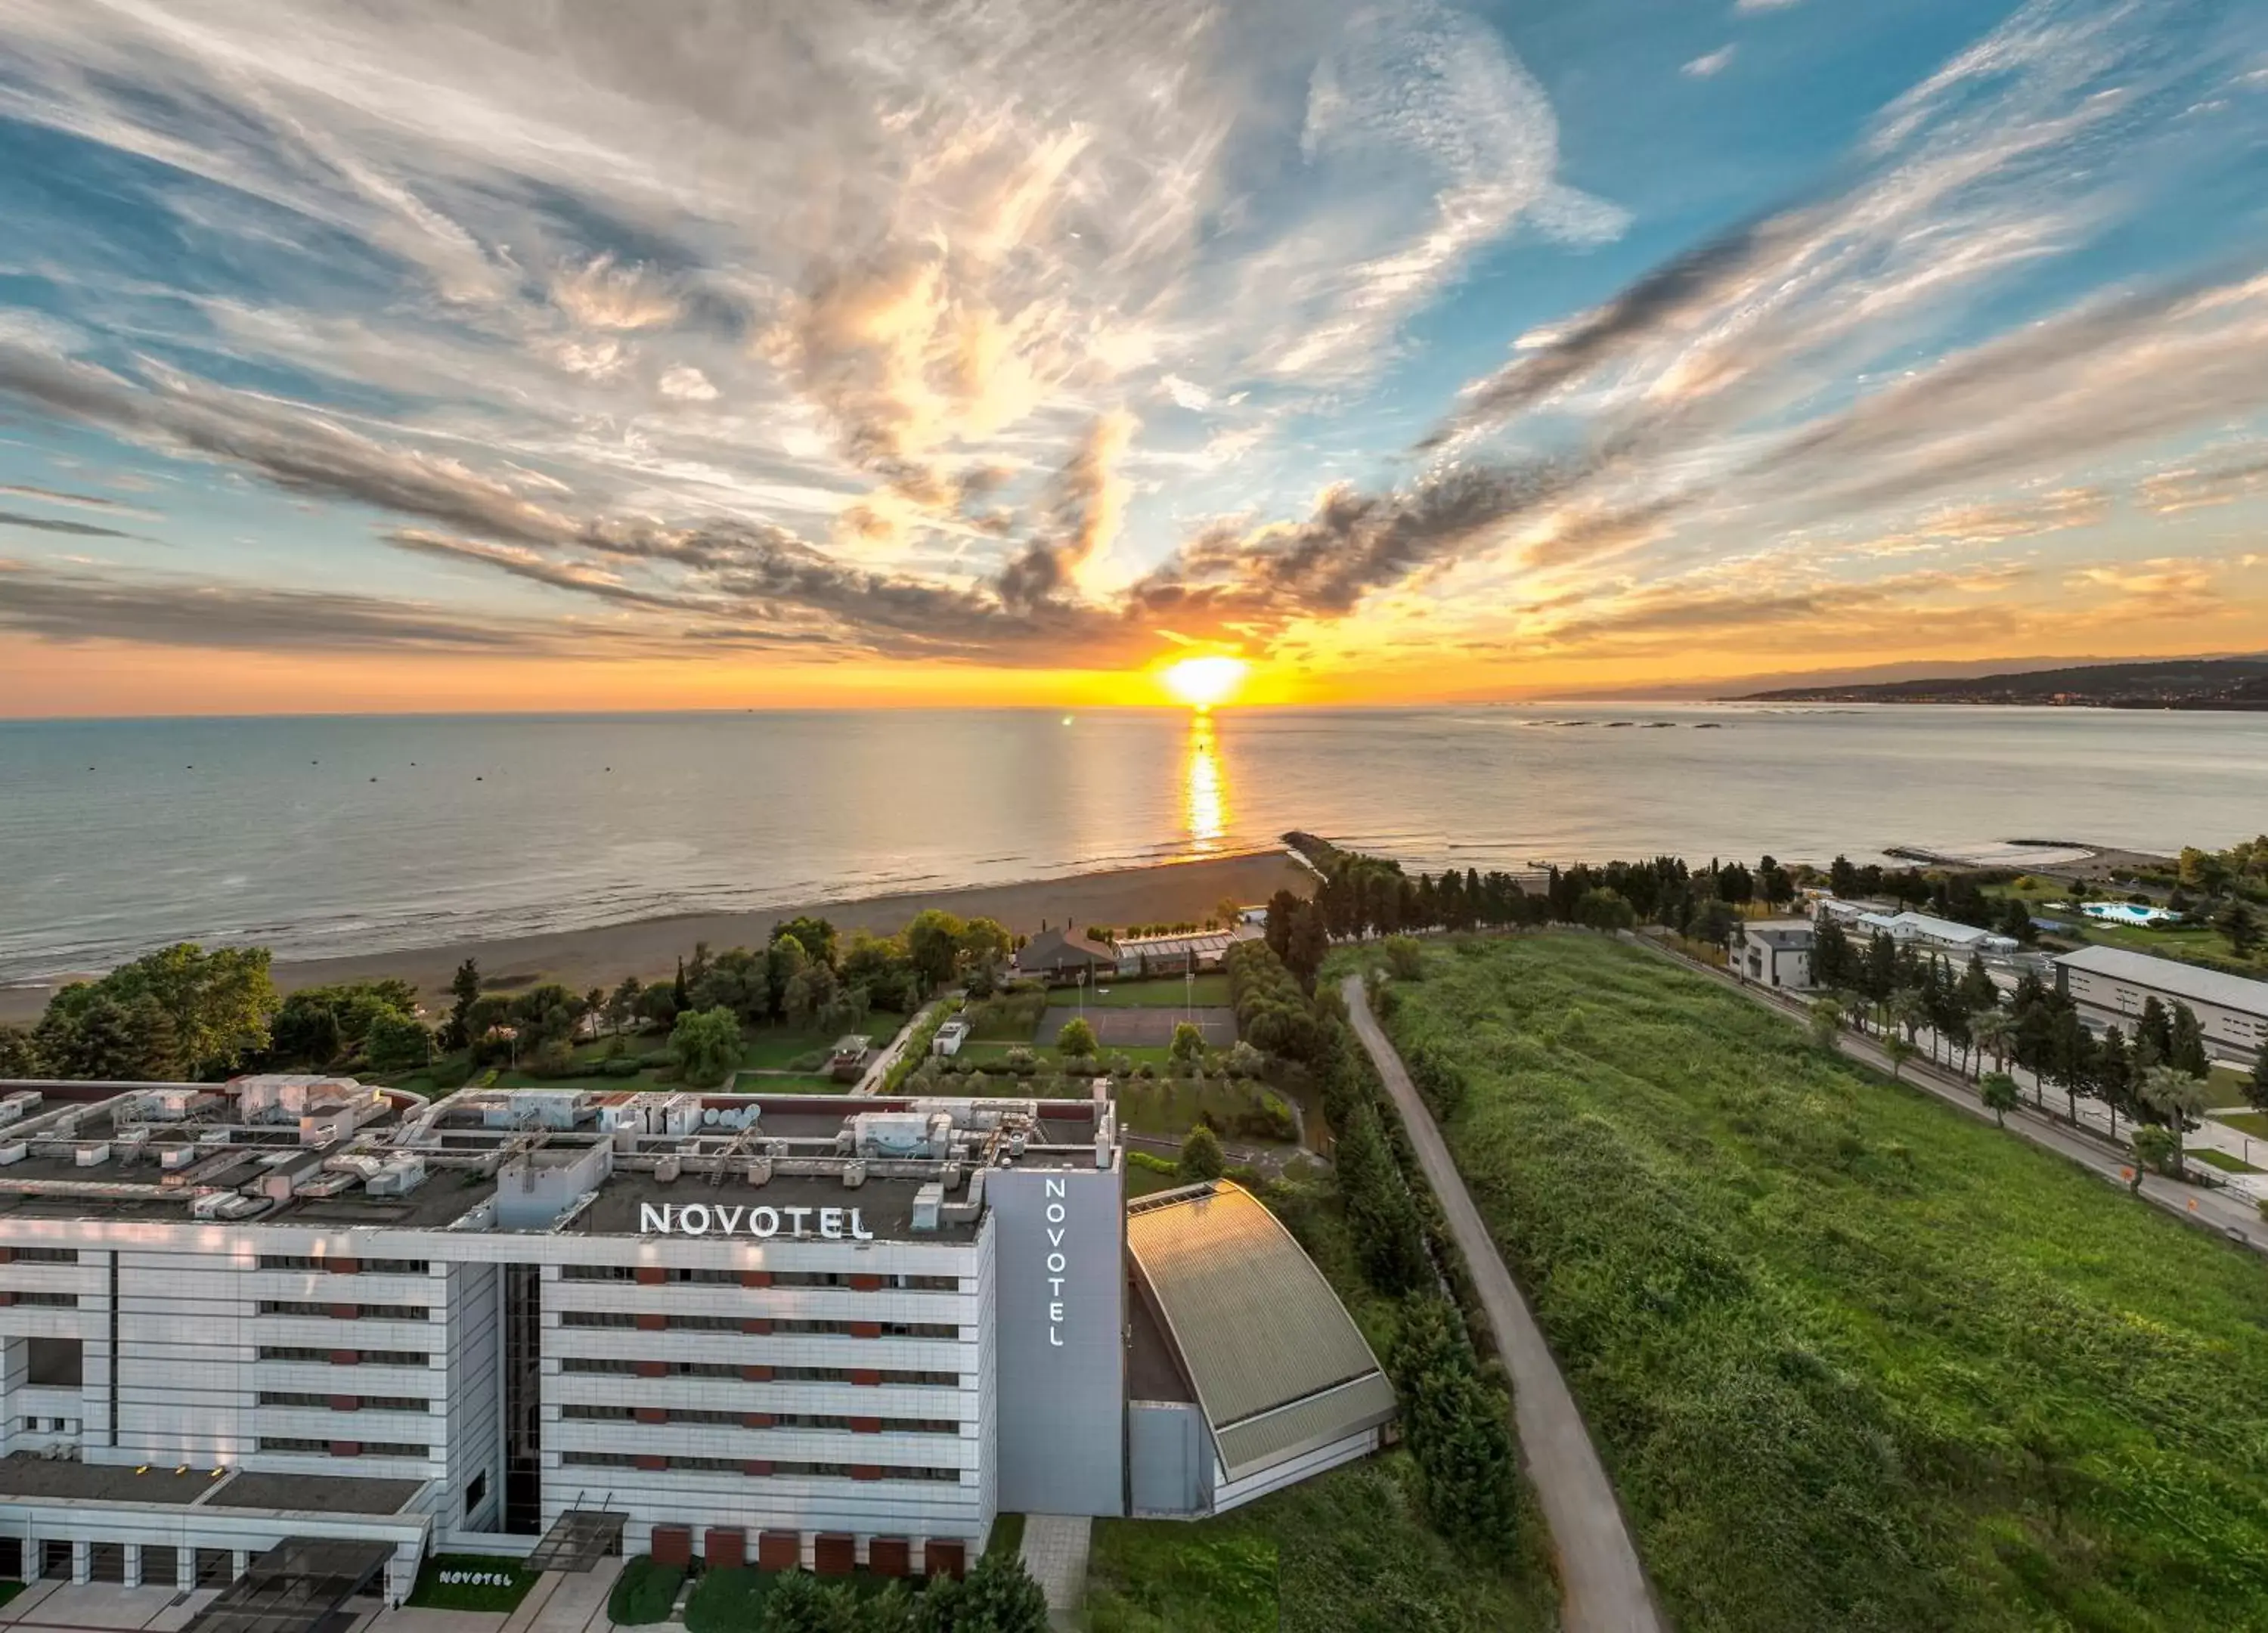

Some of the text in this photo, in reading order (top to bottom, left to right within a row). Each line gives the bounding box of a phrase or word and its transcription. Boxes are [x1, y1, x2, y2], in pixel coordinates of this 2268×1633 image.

[640, 1202, 874, 1240] NOVOTEL
[1045, 1178, 1067, 1346] NOVOTEL
[439, 1570, 513, 1587] NOVOTEL
